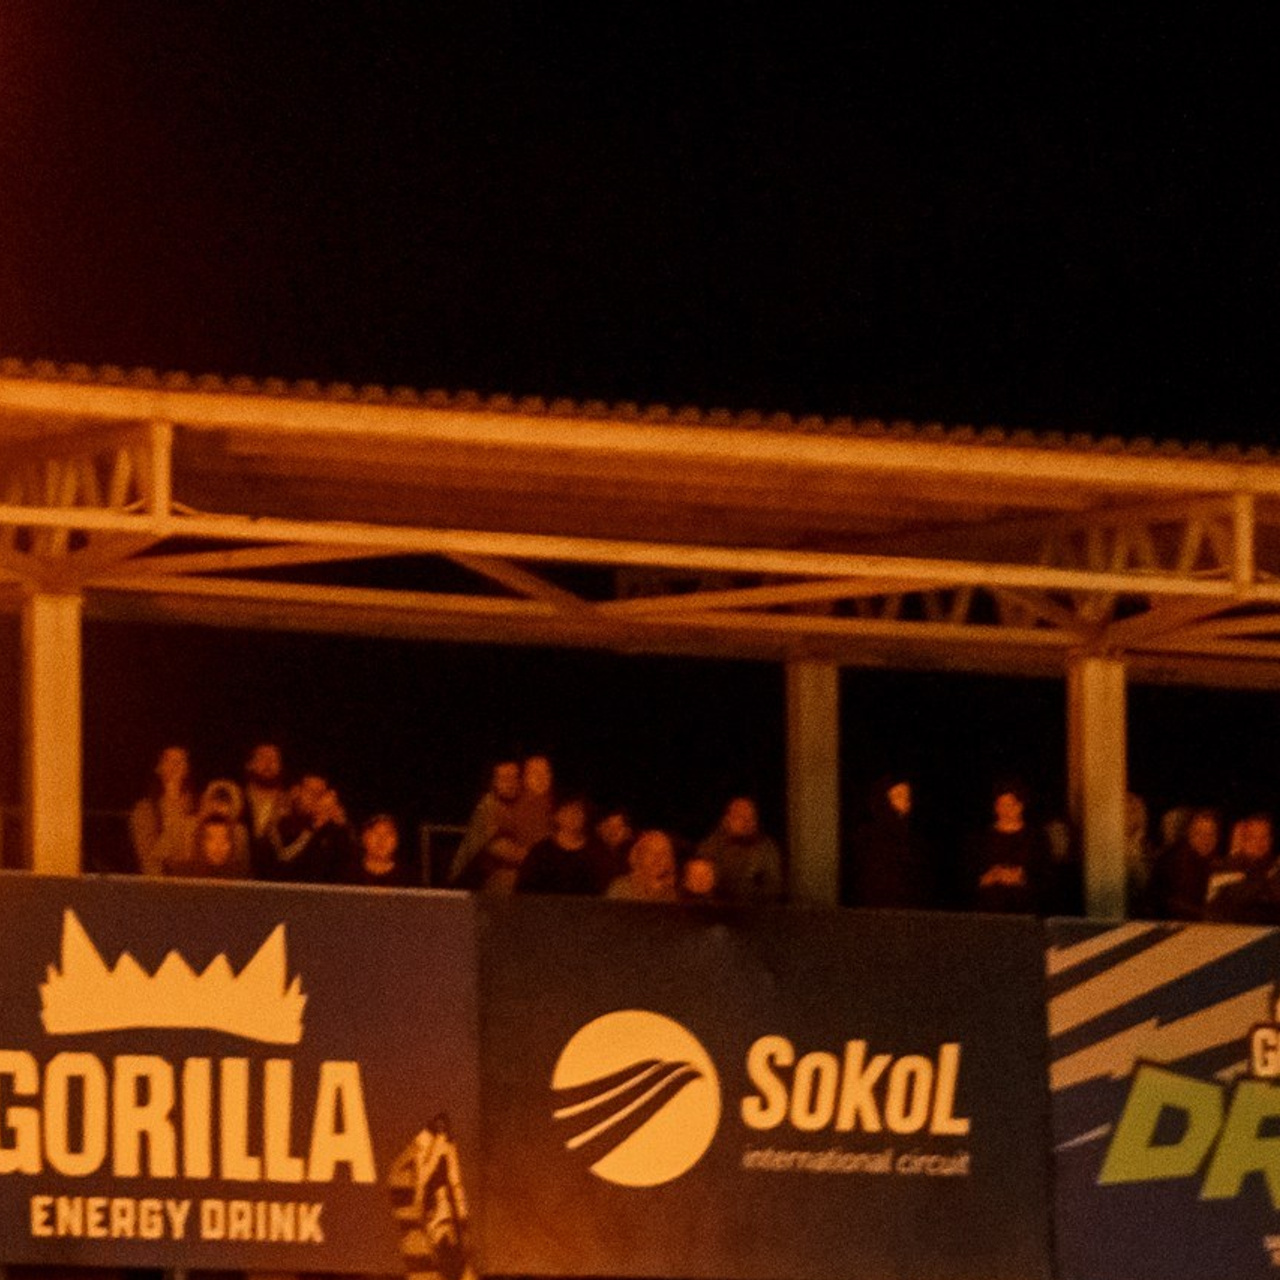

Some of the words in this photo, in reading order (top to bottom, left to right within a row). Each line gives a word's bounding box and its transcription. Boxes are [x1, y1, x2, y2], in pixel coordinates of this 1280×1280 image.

[0, 1048, 377, 1184] GORILLA
[30, 1195, 189, 1239] ENERGY
[202, 1199, 325, 1243] DRINK
